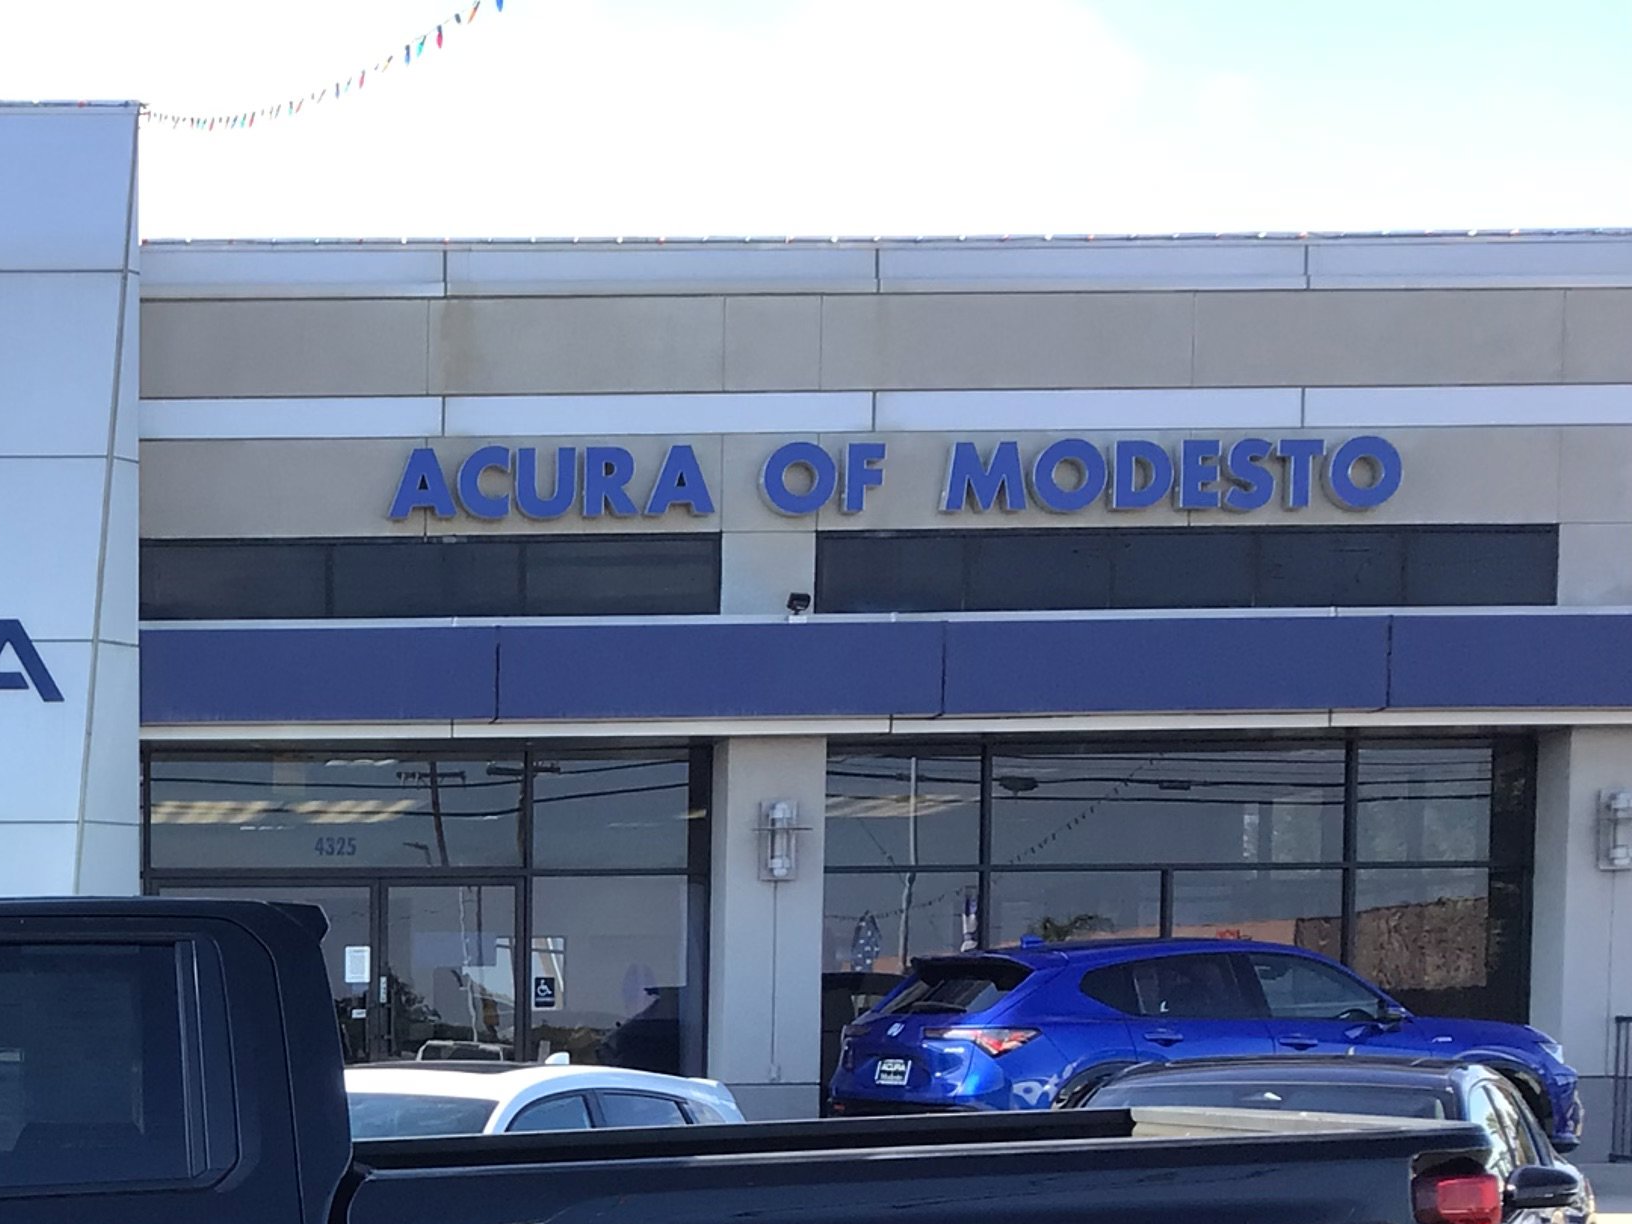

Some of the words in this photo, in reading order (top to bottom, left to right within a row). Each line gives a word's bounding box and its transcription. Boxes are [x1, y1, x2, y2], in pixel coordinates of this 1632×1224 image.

[387, 444, 716, 520] ACURA
[758, 441, 887, 517] OF
[939, 435, 1404, 513] MODESTO
[314, 836, 357, 856] 4325
